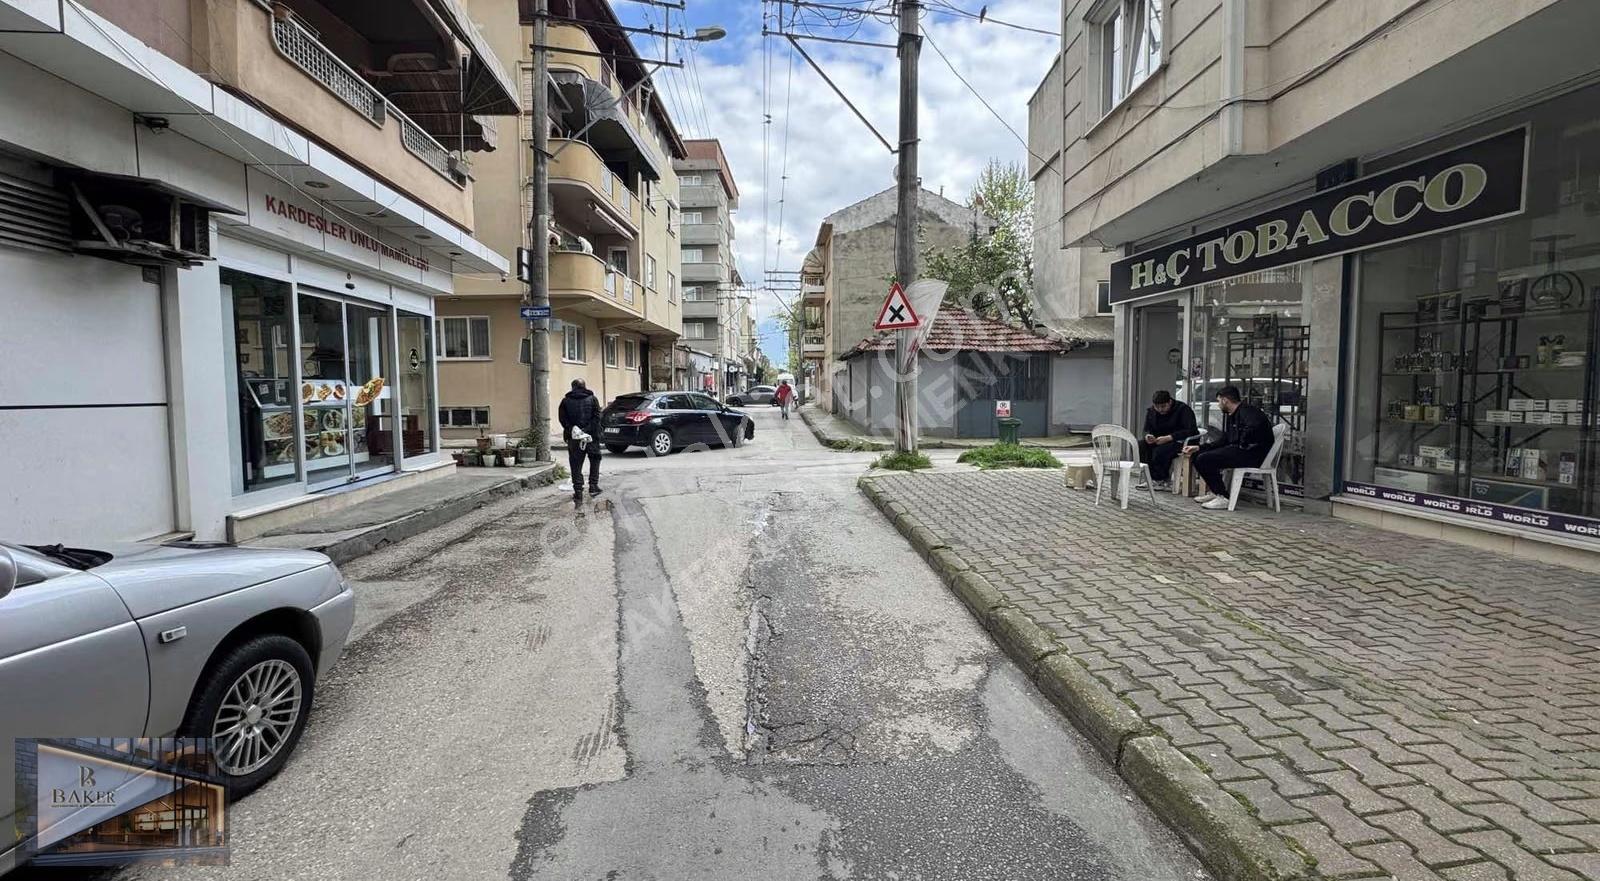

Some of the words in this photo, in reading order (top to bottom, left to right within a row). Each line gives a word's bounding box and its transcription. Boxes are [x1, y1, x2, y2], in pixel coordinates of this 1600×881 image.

[265, 194, 347, 241] KARDEŞLER
[1130, 249, 1190, 291] H&Ç
[1196, 162, 1488, 272] TOBACCO
[1347, 486, 1376, 496] WORLD
[1383, 492, 1416, 503] WORLD
[1424, 499, 1460, 511] WORLD
[1503, 513, 1549, 526] WORLD
